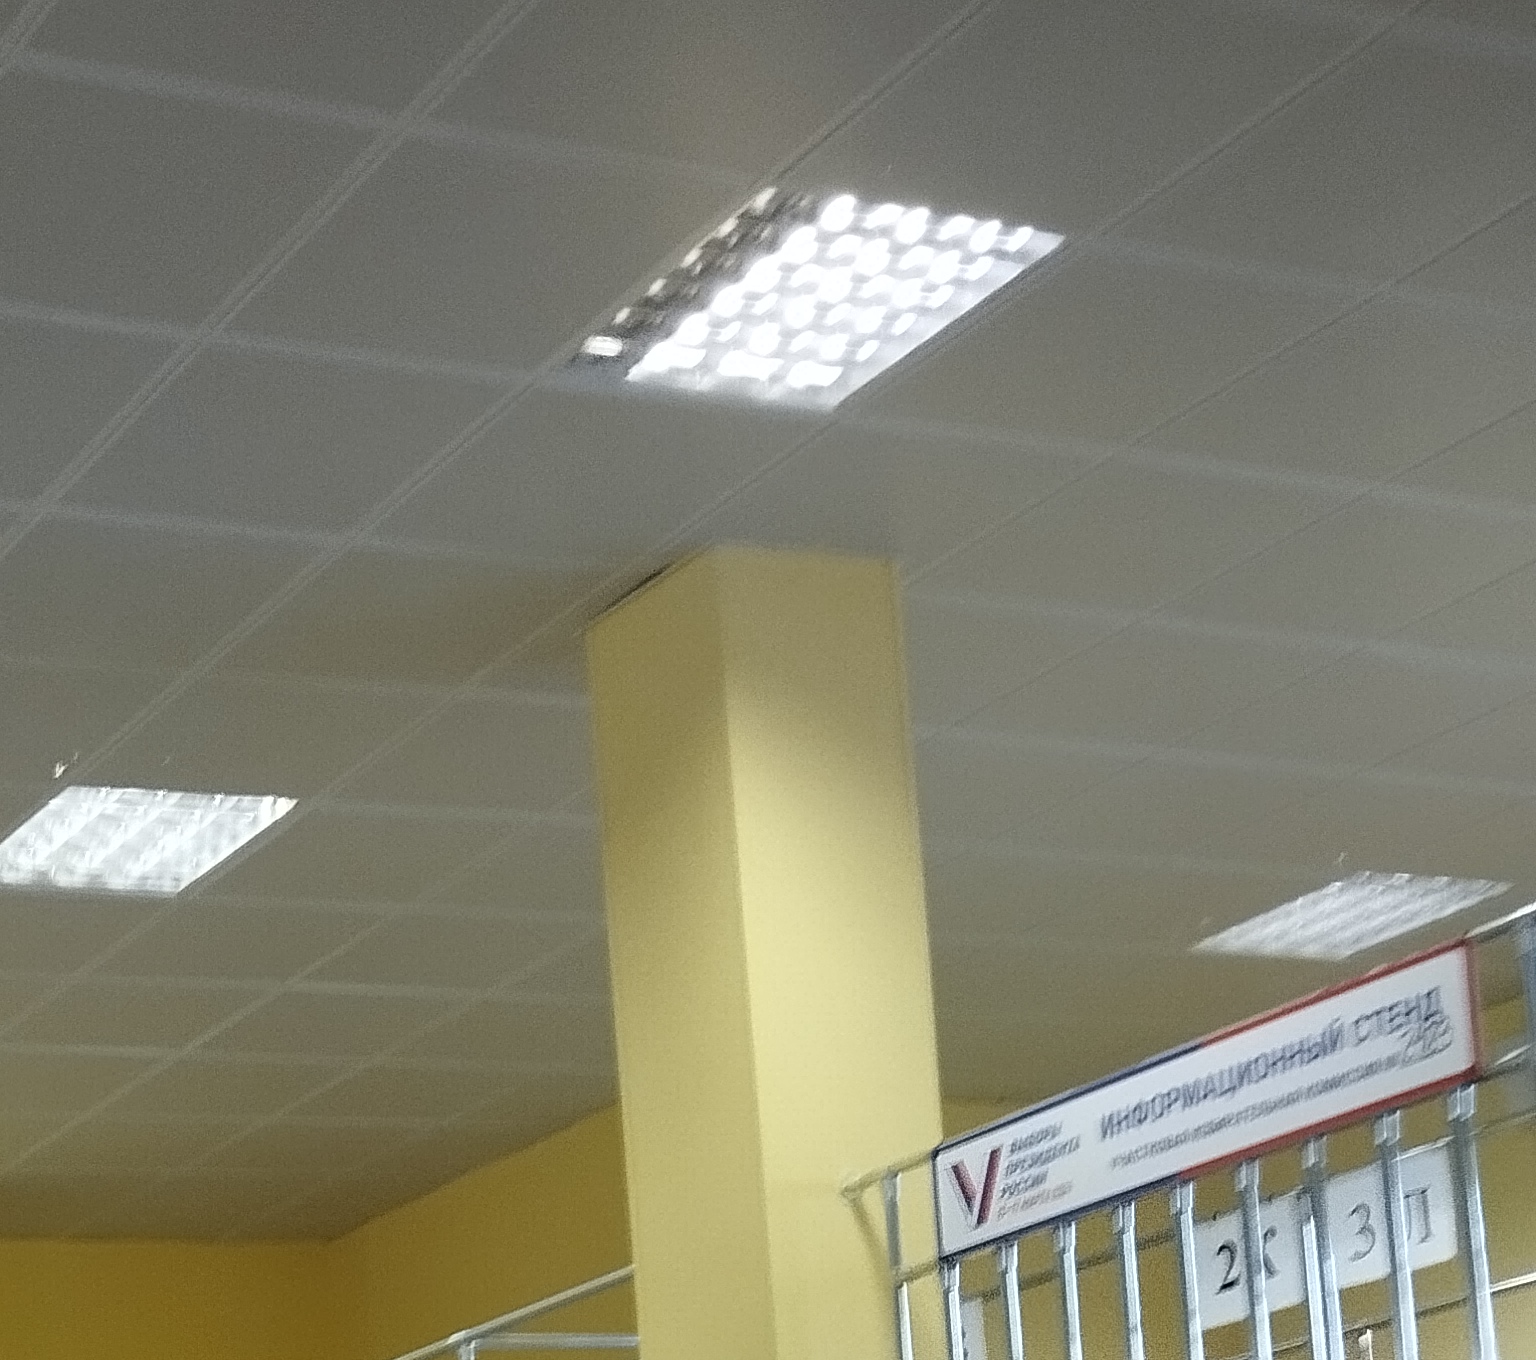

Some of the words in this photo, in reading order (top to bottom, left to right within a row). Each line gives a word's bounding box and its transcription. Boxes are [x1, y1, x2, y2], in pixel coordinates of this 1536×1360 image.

[1099, 1017, 1345, 1142] ИНФОРМАЦИОННЫЙ
[1352, 985, 1442, 1046] СТЕНД
[1216, 1239, 1242, 1295] 2
